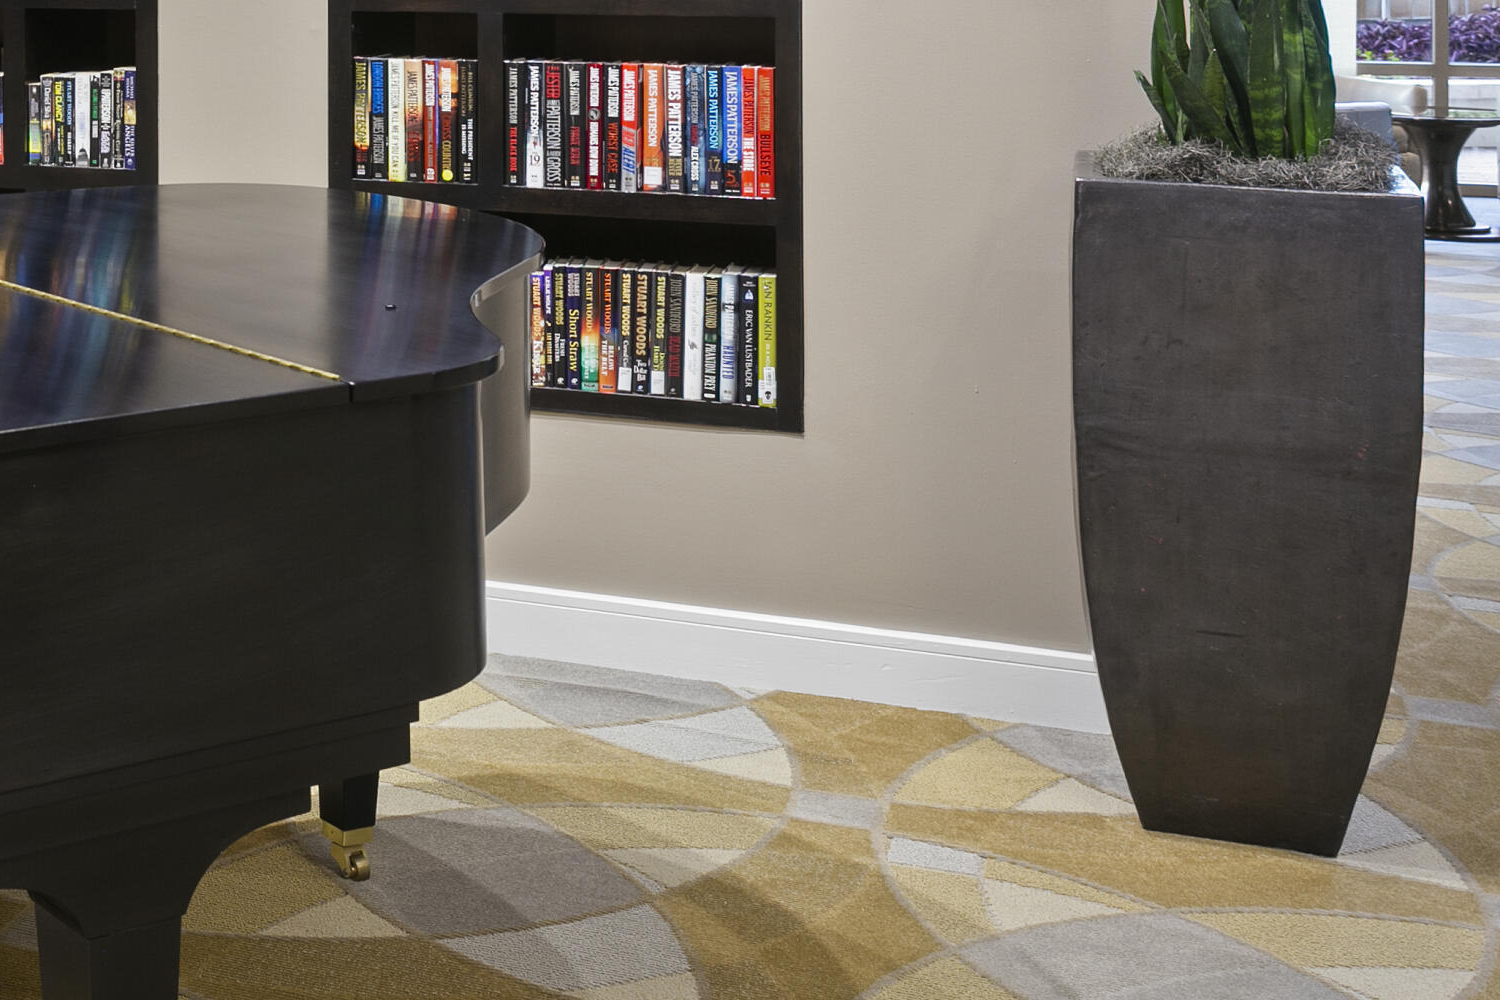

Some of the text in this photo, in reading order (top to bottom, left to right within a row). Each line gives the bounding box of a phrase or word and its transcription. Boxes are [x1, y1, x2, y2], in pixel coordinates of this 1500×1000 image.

[372, 62, 384, 114] LONDON BRIDGES
[529, 66, 539, 137] JAMES PATTERSON
[668, 69, 682, 157] JAMES PATTERSON
[707, 70, 718, 149] JAMES PATTERSON
[725, 71, 738, 164] JAMES PATTERSON
[546, 72, 561, 182] JESTER PATTERSON GROSS
[608, 122, 618, 174] WORST CASE
[743, 137, 755, 172] THE STORE
[760, 133, 771, 176] BULLSEYE
[622, 146, 635, 174] ALERT
[622, 273, 631, 336] STUART WOODS
[636, 274, 648, 356] STUART WOODS
[656, 276, 665, 339] STUART WOODS
[704, 279, 717, 391] JOHN SANDFORD PHANTOM PREY
[764, 281, 773, 341] IAN RANKIN
[568, 309, 580, 372] Short Straw
[722, 345, 734, 380] HAUNTED
[745, 309, 754, 388] ERIC VAN LUSTBADER
